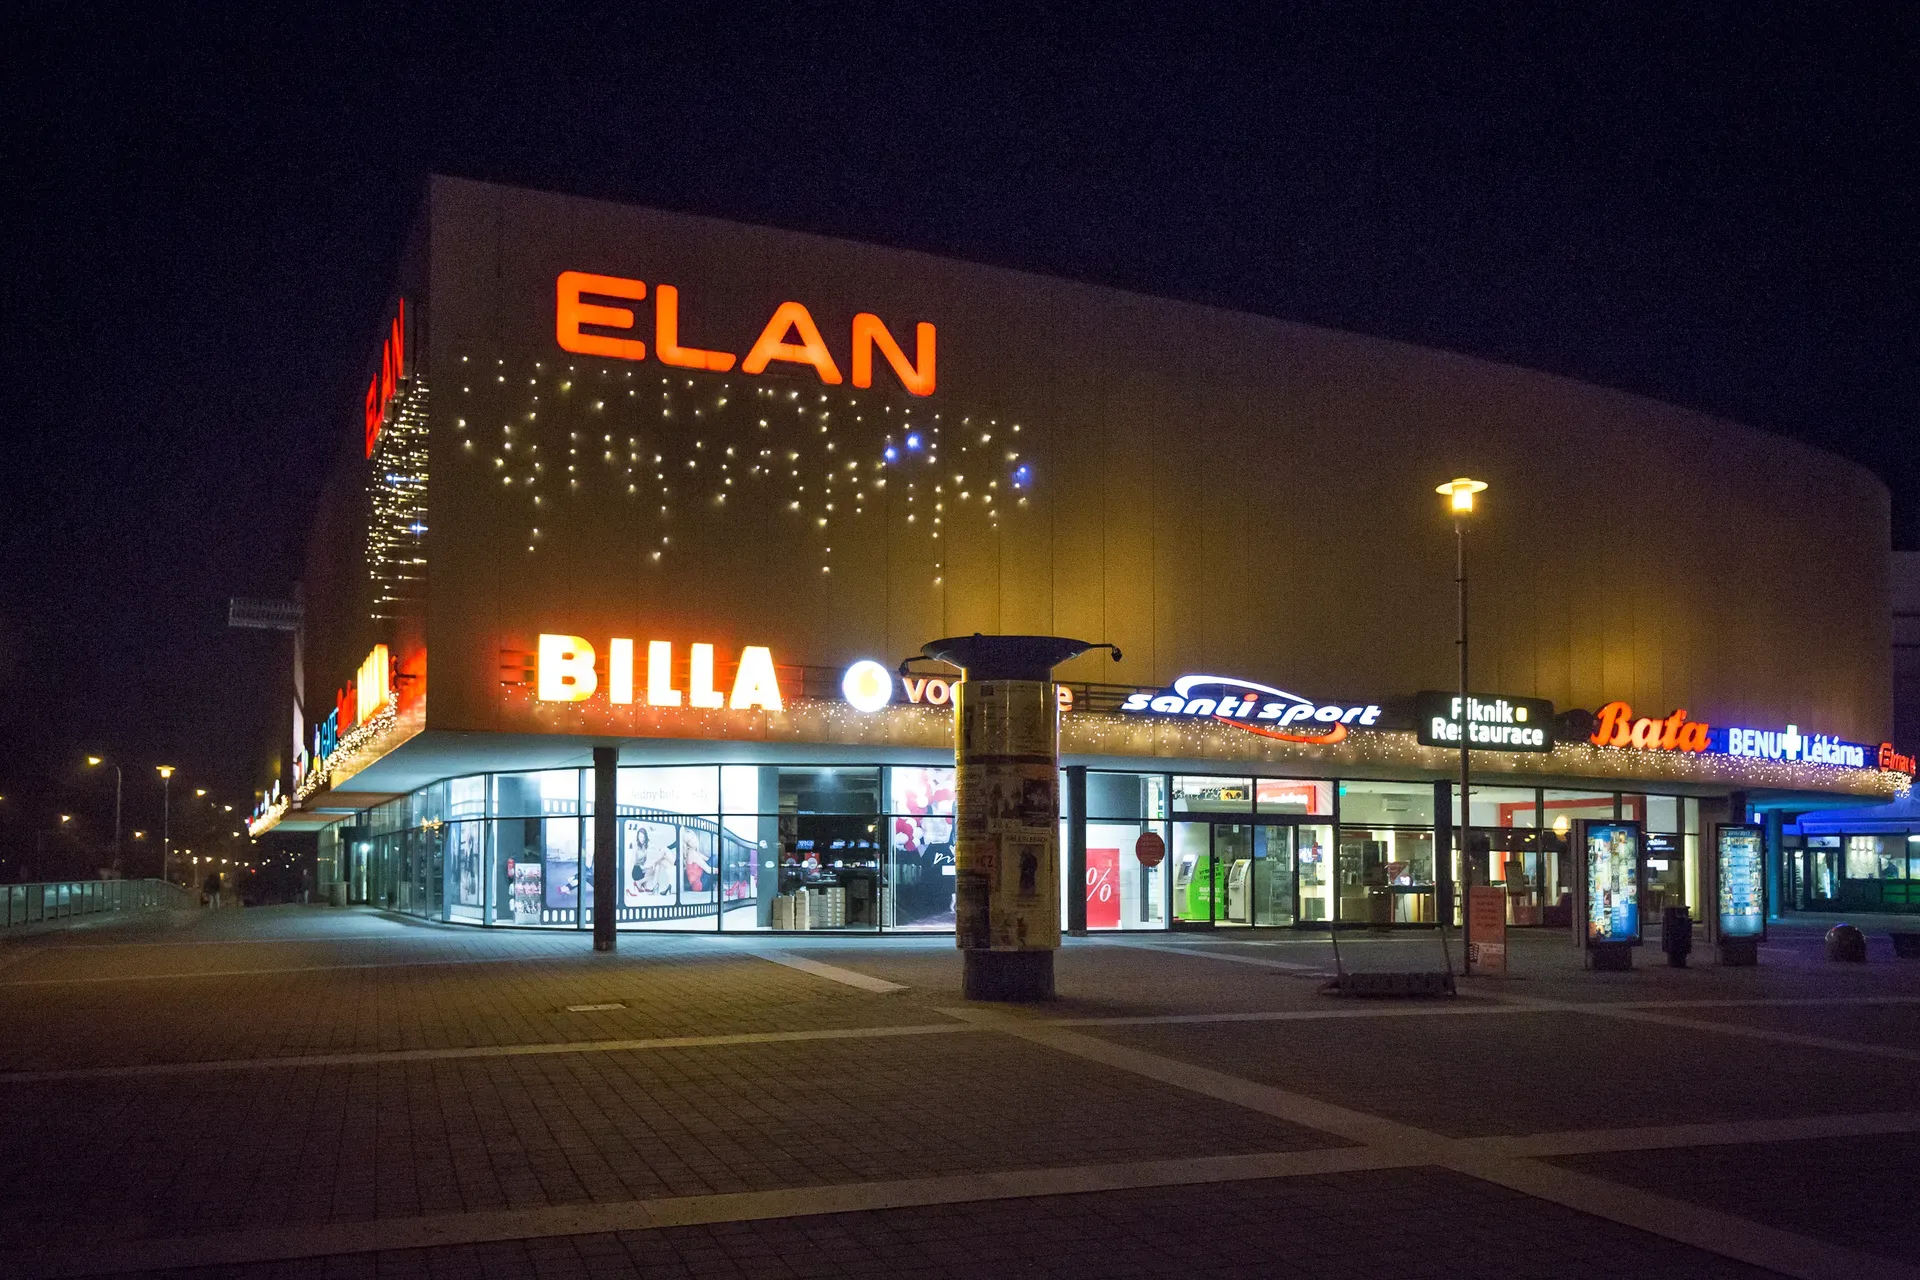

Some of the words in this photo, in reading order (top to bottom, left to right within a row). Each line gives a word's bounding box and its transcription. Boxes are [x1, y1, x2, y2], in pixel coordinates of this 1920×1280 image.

[556, 271, 936, 397] ELAN
[538, 634, 783, 711] BILLA
[1121, 693, 1258, 717] santi
[1257, 703, 1382, 727] sport
[1451, 697, 1513, 723] Piknik
[1729, 728, 1782, 758] BENU
[1803, 734, 1864, 767] Lékárna
